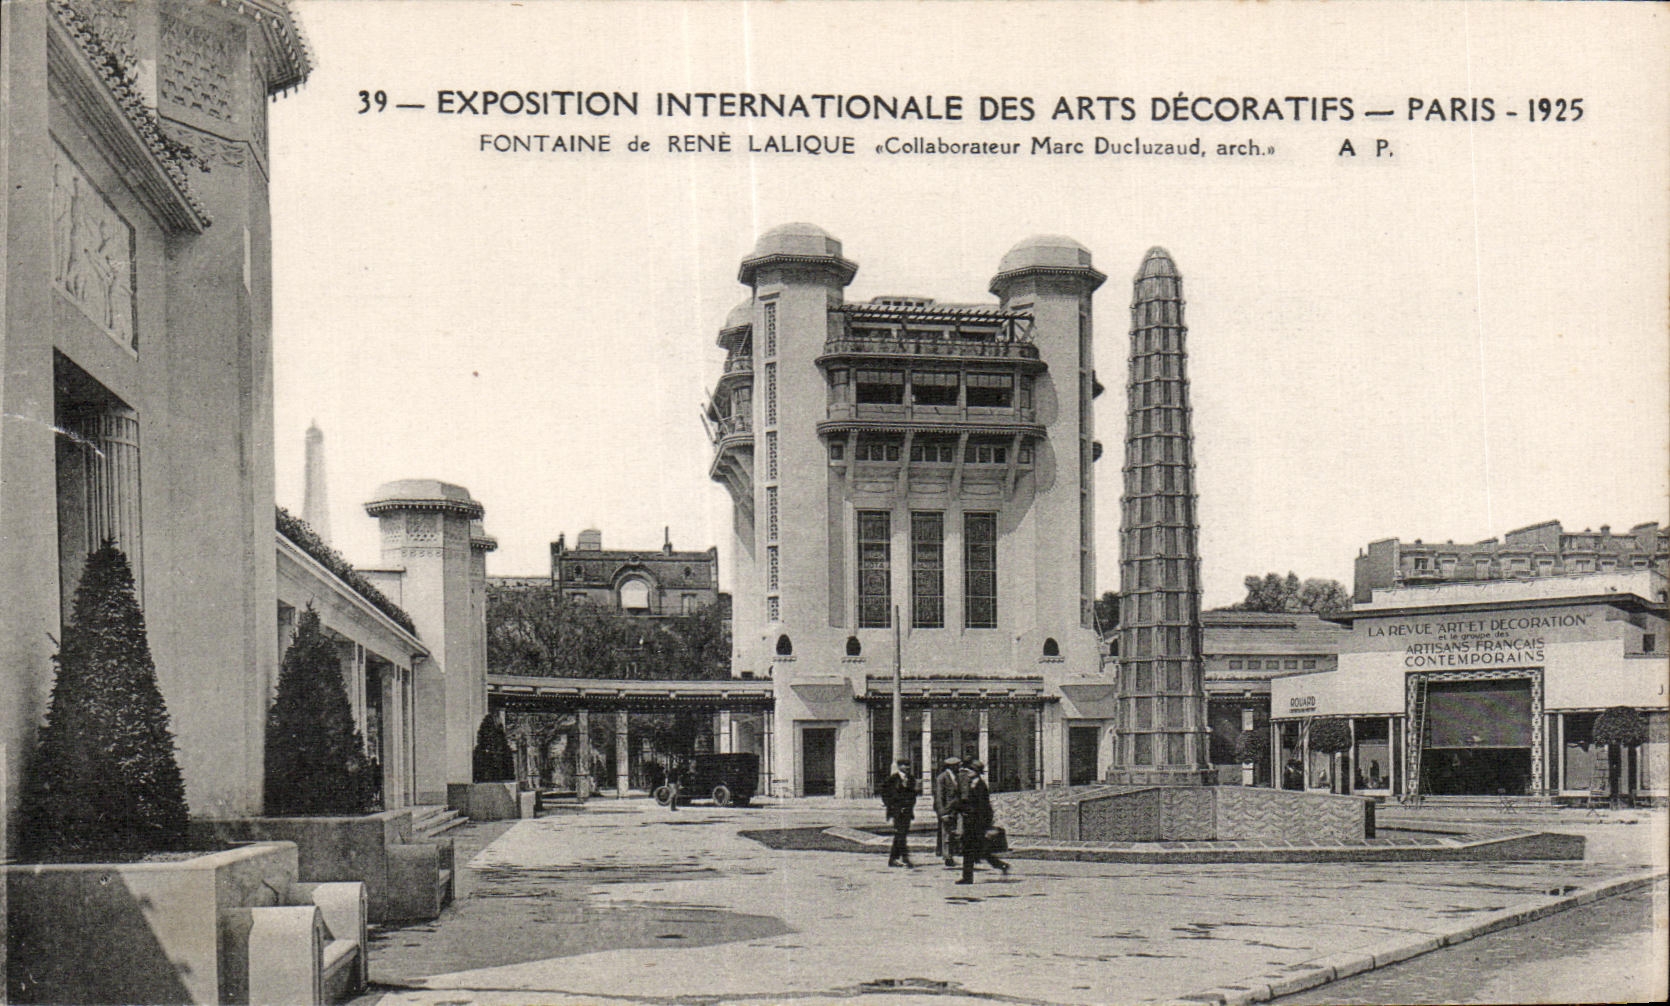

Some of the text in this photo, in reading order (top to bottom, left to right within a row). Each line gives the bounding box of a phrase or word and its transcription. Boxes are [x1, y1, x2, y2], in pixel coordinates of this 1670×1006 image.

[1368, 627, 1385, 637] LA
[1388, 624, 1432, 636] REVUE
[1438, 633, 1447, 641] et
[1461, 633, 1491, 641] groupe
[1406, 637, 1545, 655] ARTISANS FRANÇAIS
[1404, 650, 1545, 667] CONTEMPORAINS
